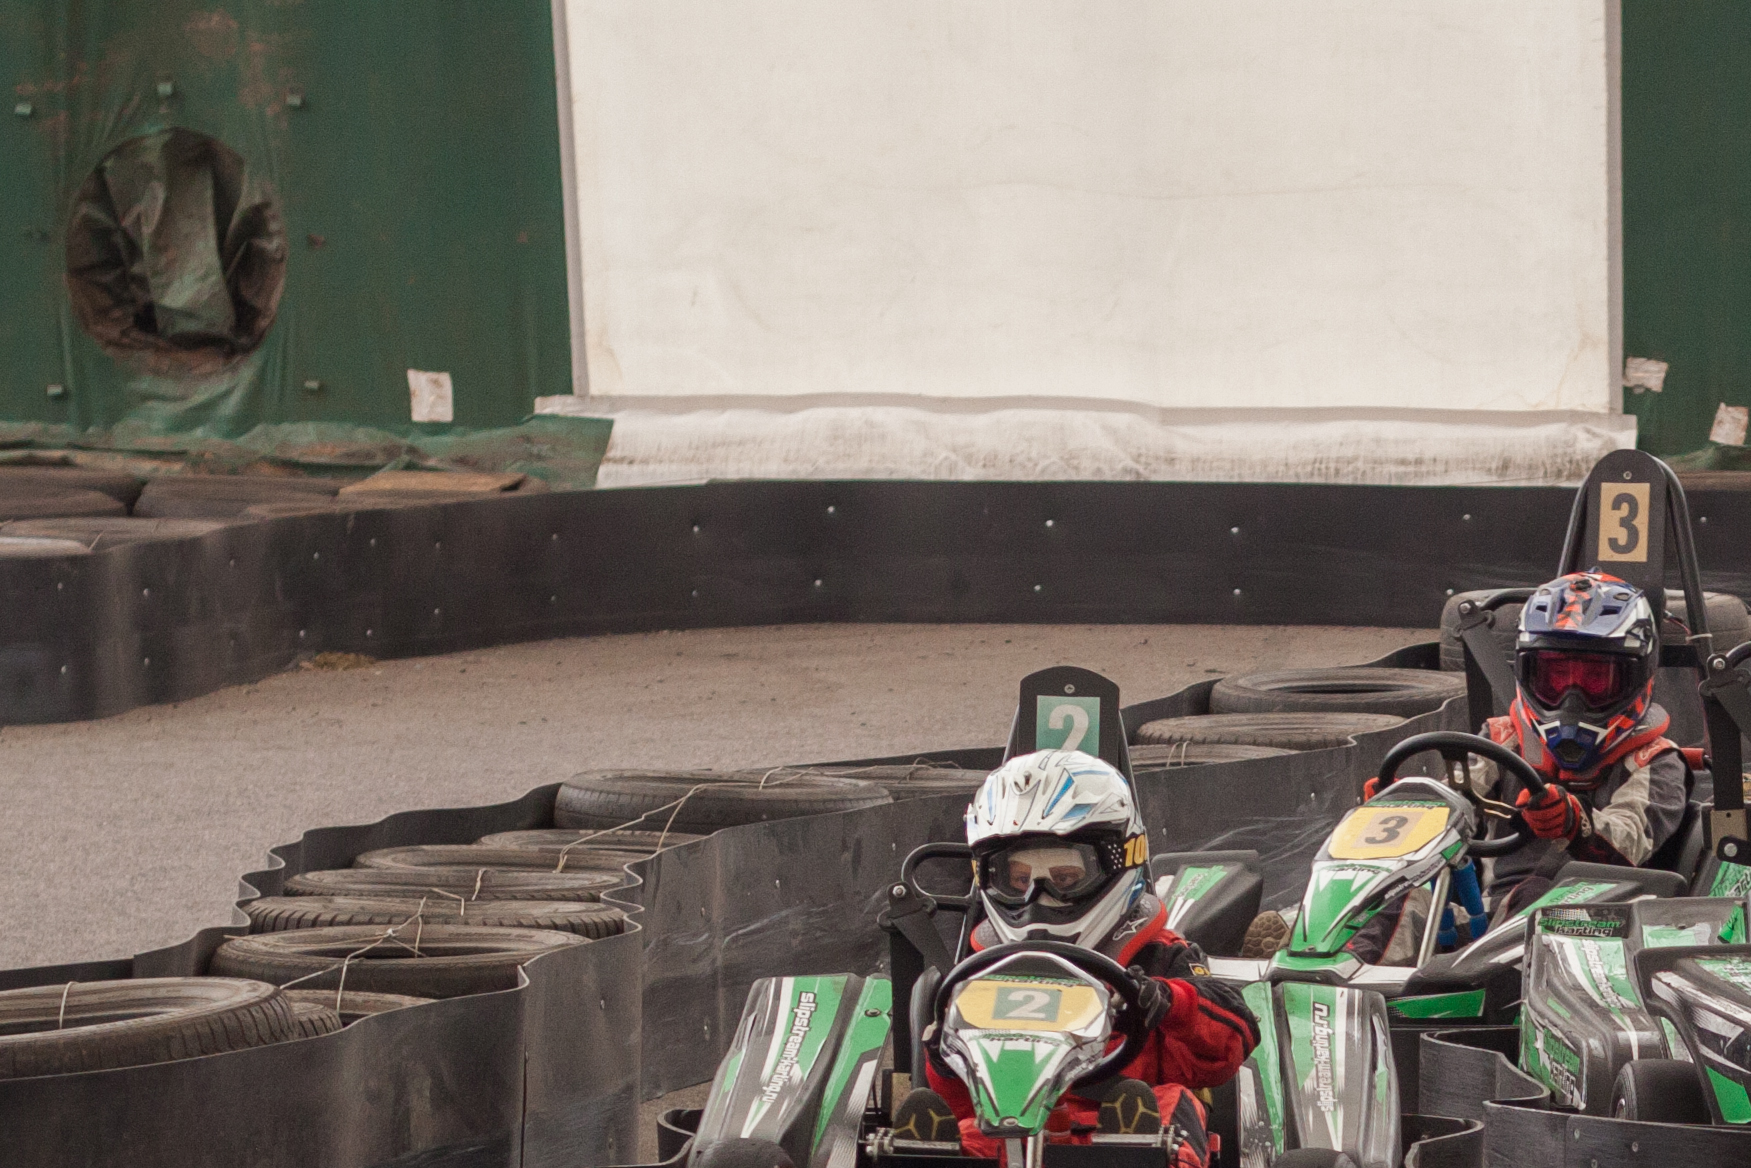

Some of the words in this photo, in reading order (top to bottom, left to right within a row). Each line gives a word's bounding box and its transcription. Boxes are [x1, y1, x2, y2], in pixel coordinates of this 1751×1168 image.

[1607, 492, 1641, 555] 3
[1048, 703, 1090, 752] 2
[1364, 815, 1409, 845] 3
[1004, 989, 1052, 1019] 2
